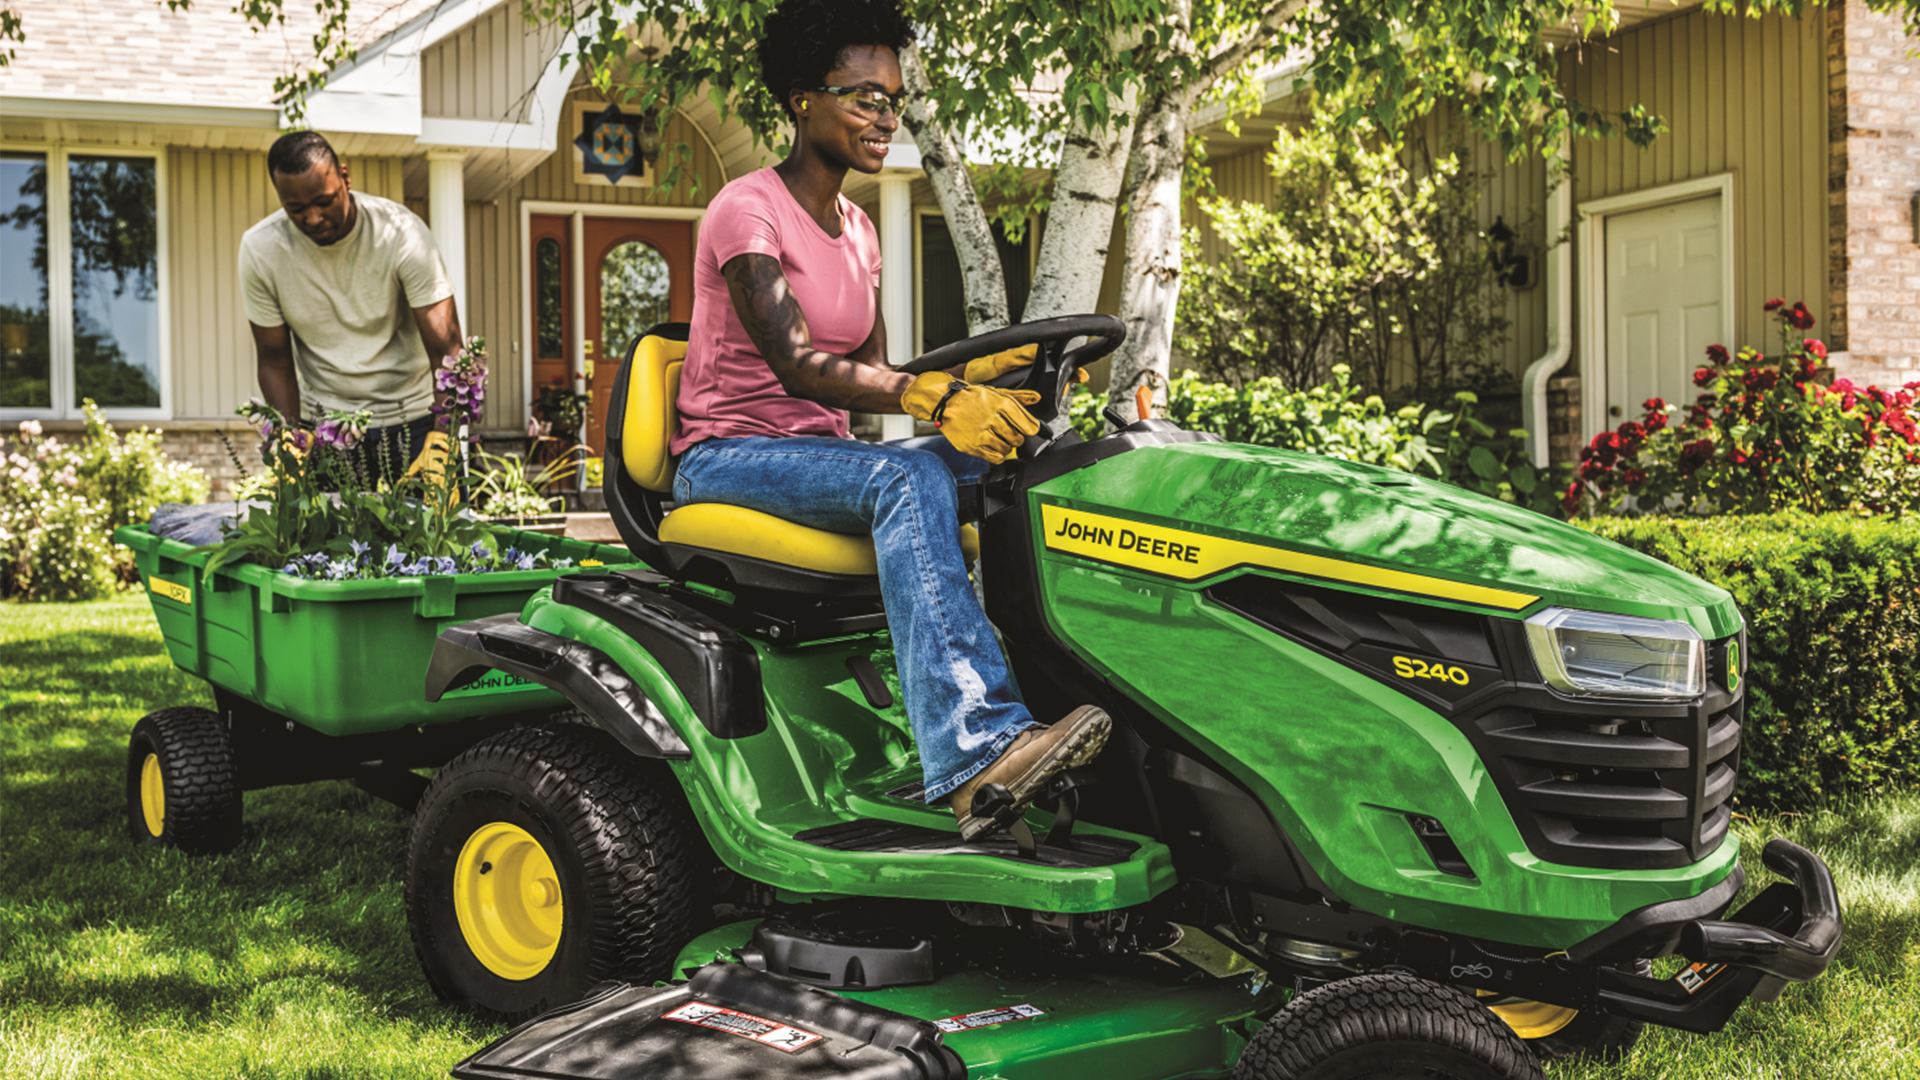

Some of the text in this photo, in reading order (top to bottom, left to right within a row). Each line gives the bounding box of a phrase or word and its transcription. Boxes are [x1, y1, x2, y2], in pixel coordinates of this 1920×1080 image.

[1055, 517, 1201, 564] JOHN DEERE
[1392, 655, 1469, 686] S240
